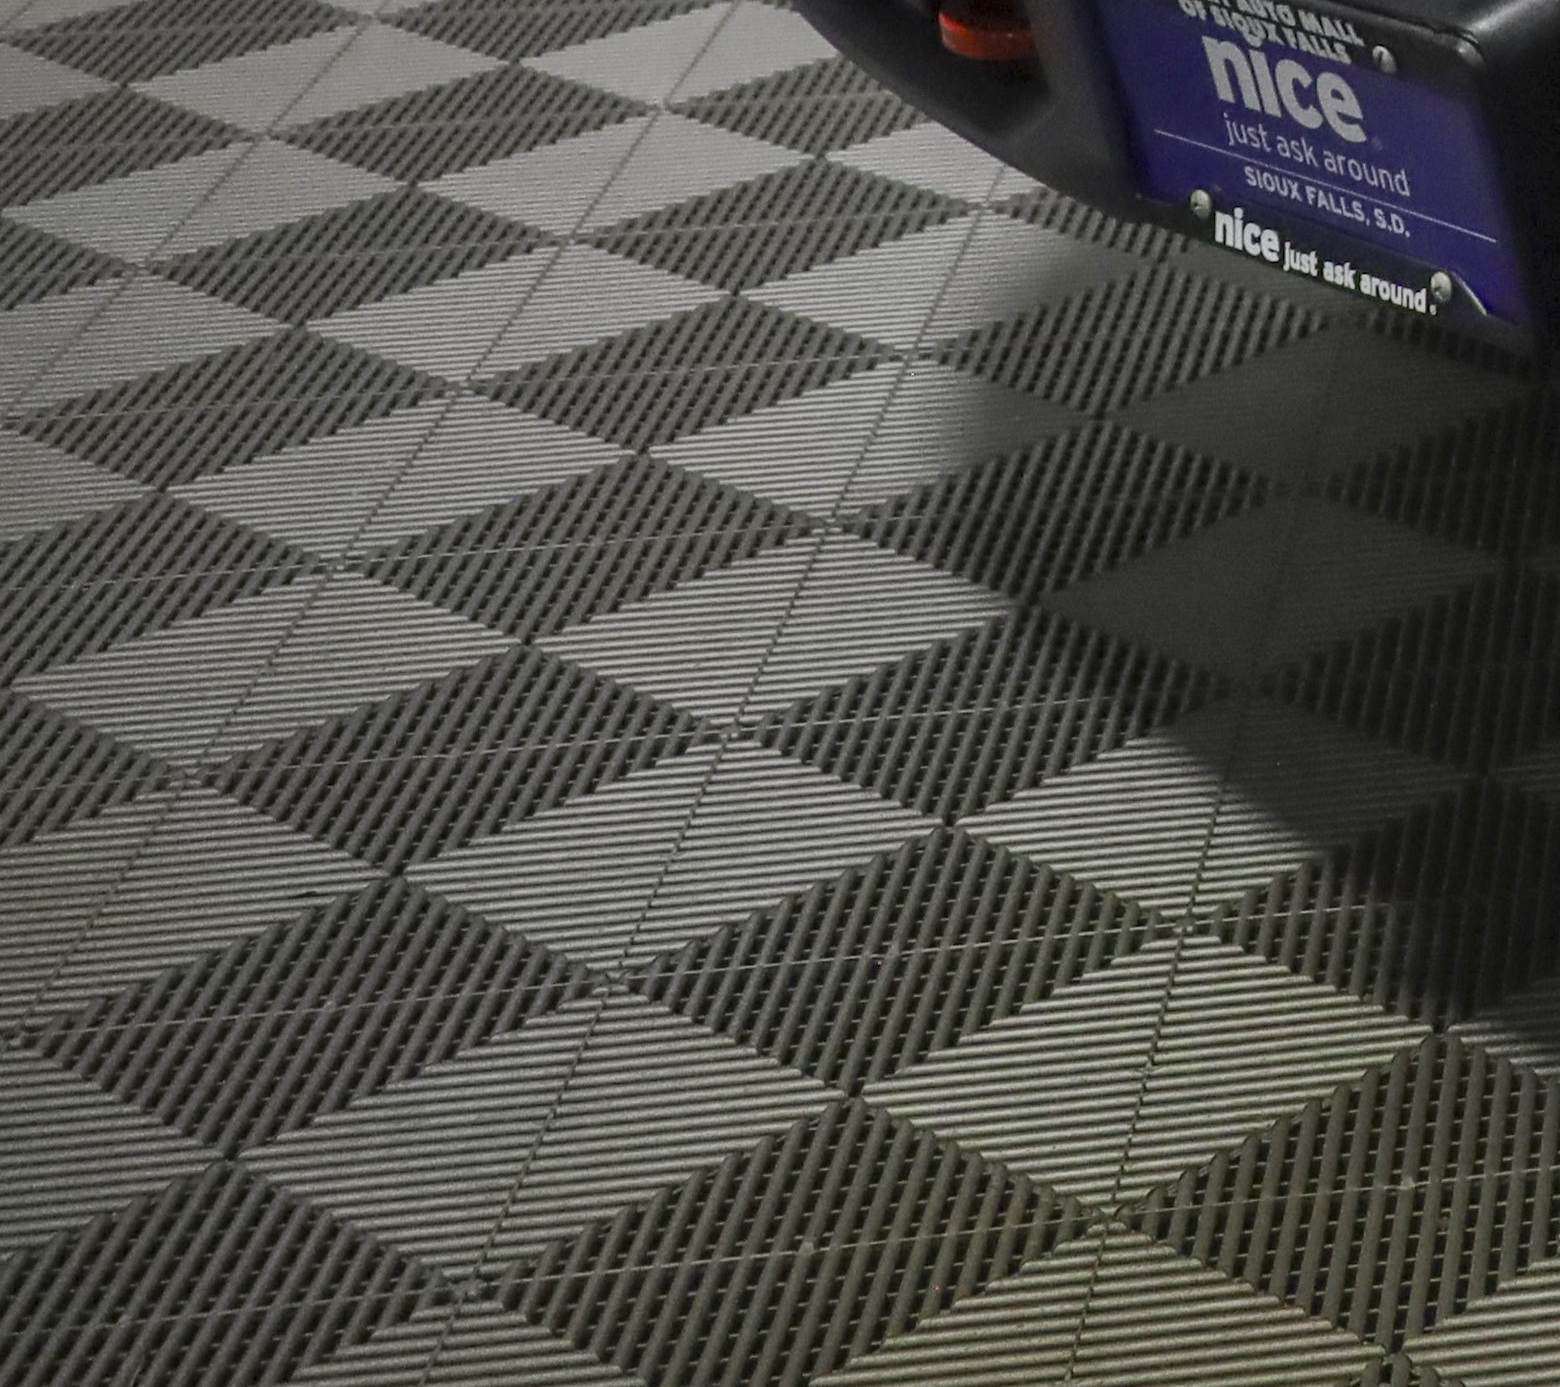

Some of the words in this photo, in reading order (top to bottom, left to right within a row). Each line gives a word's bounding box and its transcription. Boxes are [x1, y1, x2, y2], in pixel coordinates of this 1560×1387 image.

[1209, 4, 1285, 46] SIOUX
[1281, 26, 1352, 65] FALLS
[1298, 8, 1365, 47] MALL
[1201, 31, 1368, 143] nice
[1223, 112, 1272, 153] just
[1276, 135, 1319, 168] ask
[1323, 149, 1411, 197] around
[1243, 165, 1303, 202] SIOUX
[1305, 185, 1371, 226] FALLS,
[1373, 207, 1411, 237] S.D.
[1214, 206, 1280, 263] nice
[1282, 241, 1318, 272] just
[1322, 260, 1357, 290] ask
